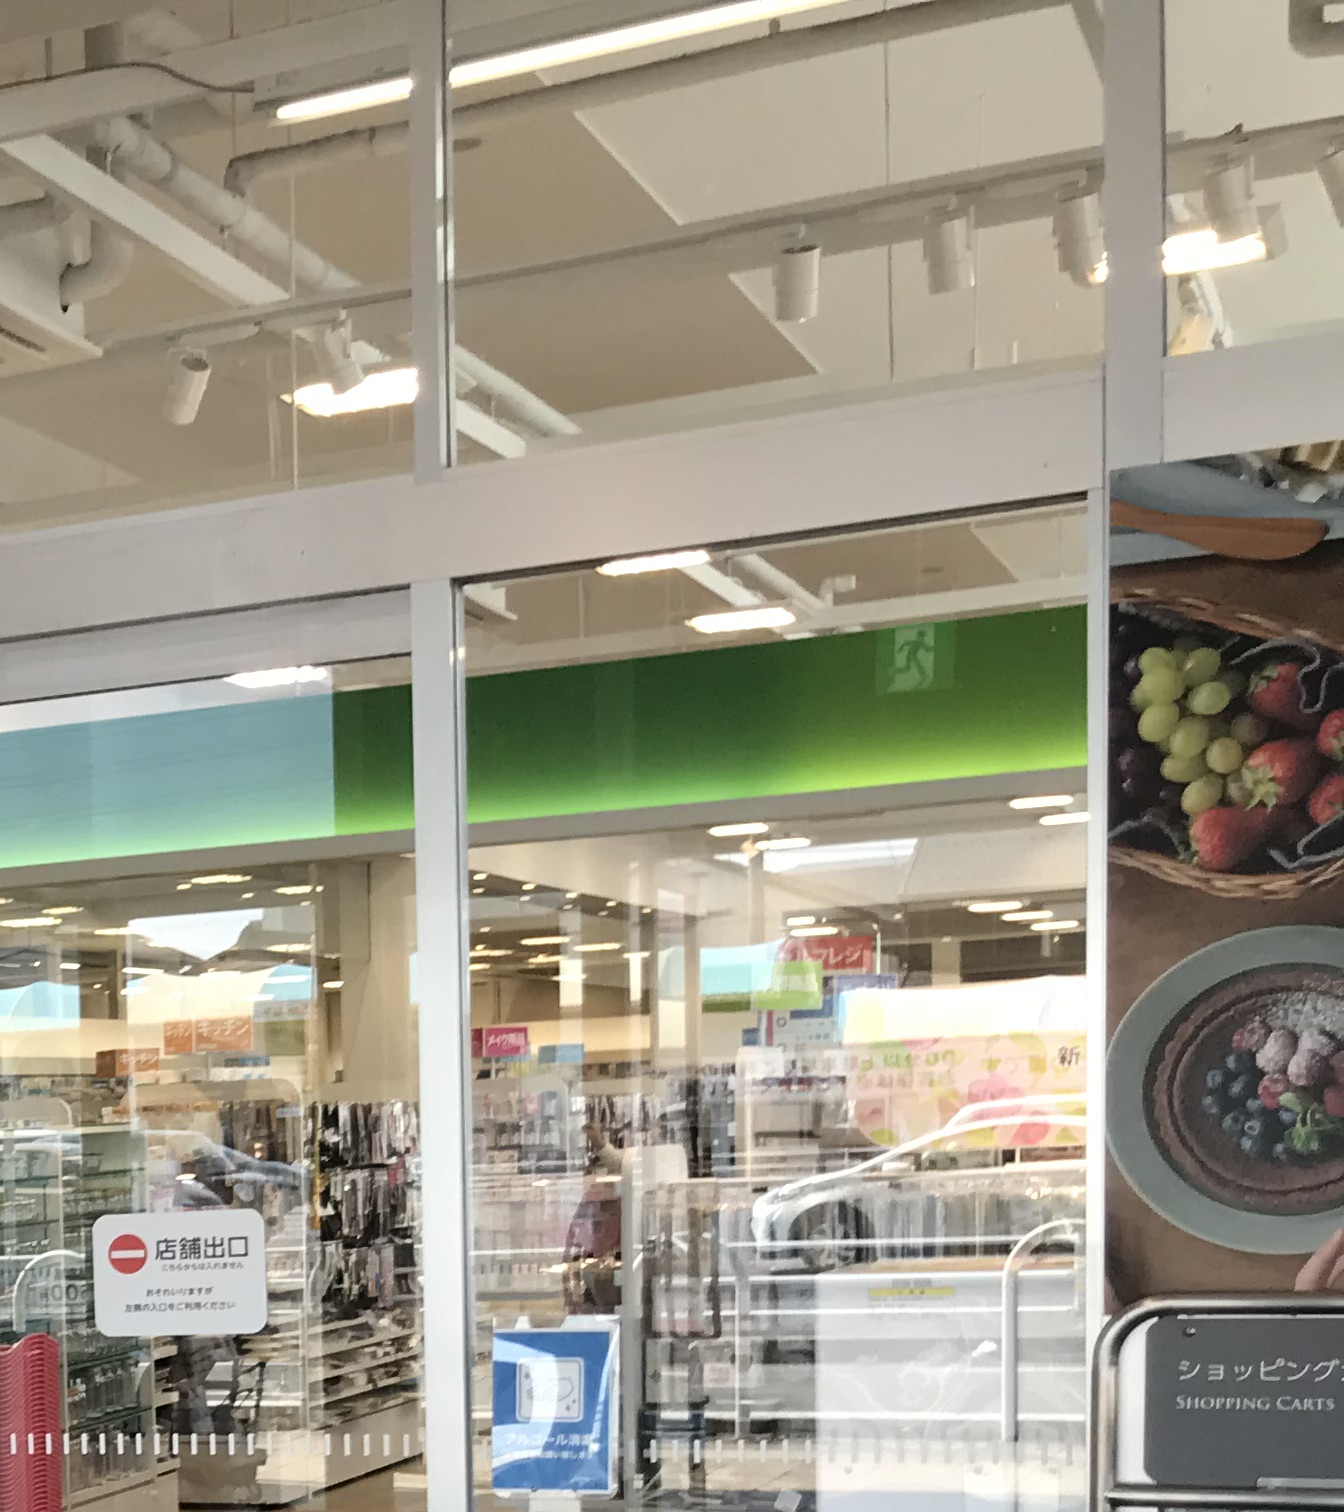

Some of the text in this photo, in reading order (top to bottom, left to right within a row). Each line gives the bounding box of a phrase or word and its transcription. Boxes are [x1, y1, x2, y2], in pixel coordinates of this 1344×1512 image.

[196, 1019, 249, 1037] キッチン
[154, 1235, 249, 1260] 店舗出口
[1178, 1358, 1344, 1382] ショッピング
[1176, 1395, 1335, 1411] SHOPPING CARTS
